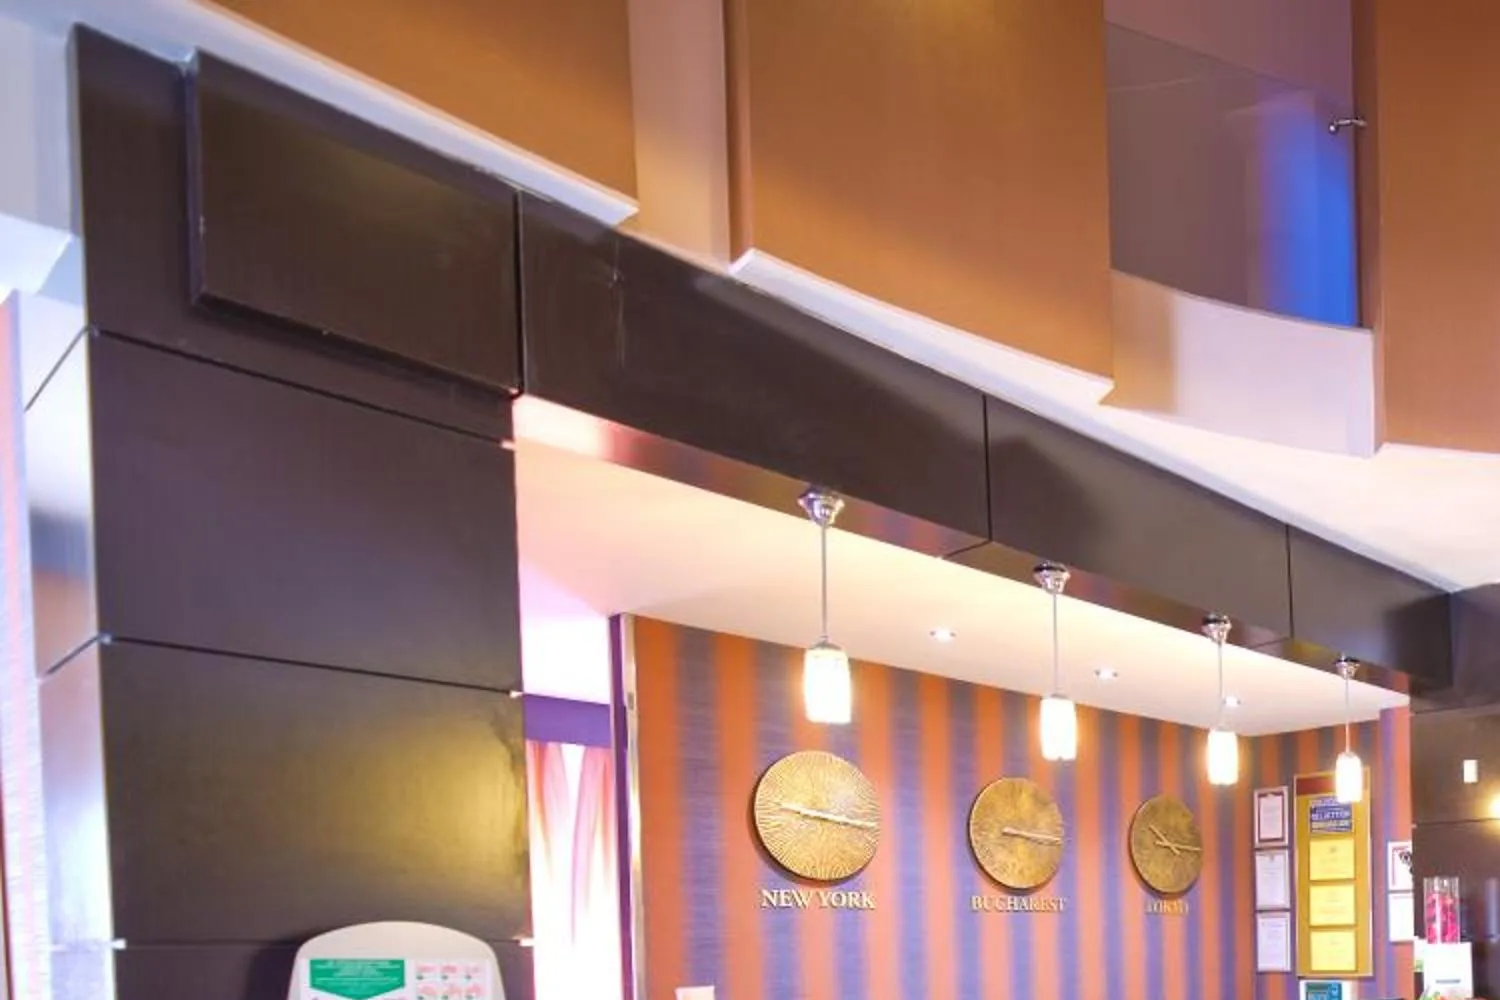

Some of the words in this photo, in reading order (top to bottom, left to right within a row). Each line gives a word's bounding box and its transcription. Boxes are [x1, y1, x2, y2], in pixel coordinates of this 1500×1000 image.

[760, 888, 814, 909] NEW
[817, 889, 877, 911] YORK
[970, 895, 1066, 912] BUCHAREST
